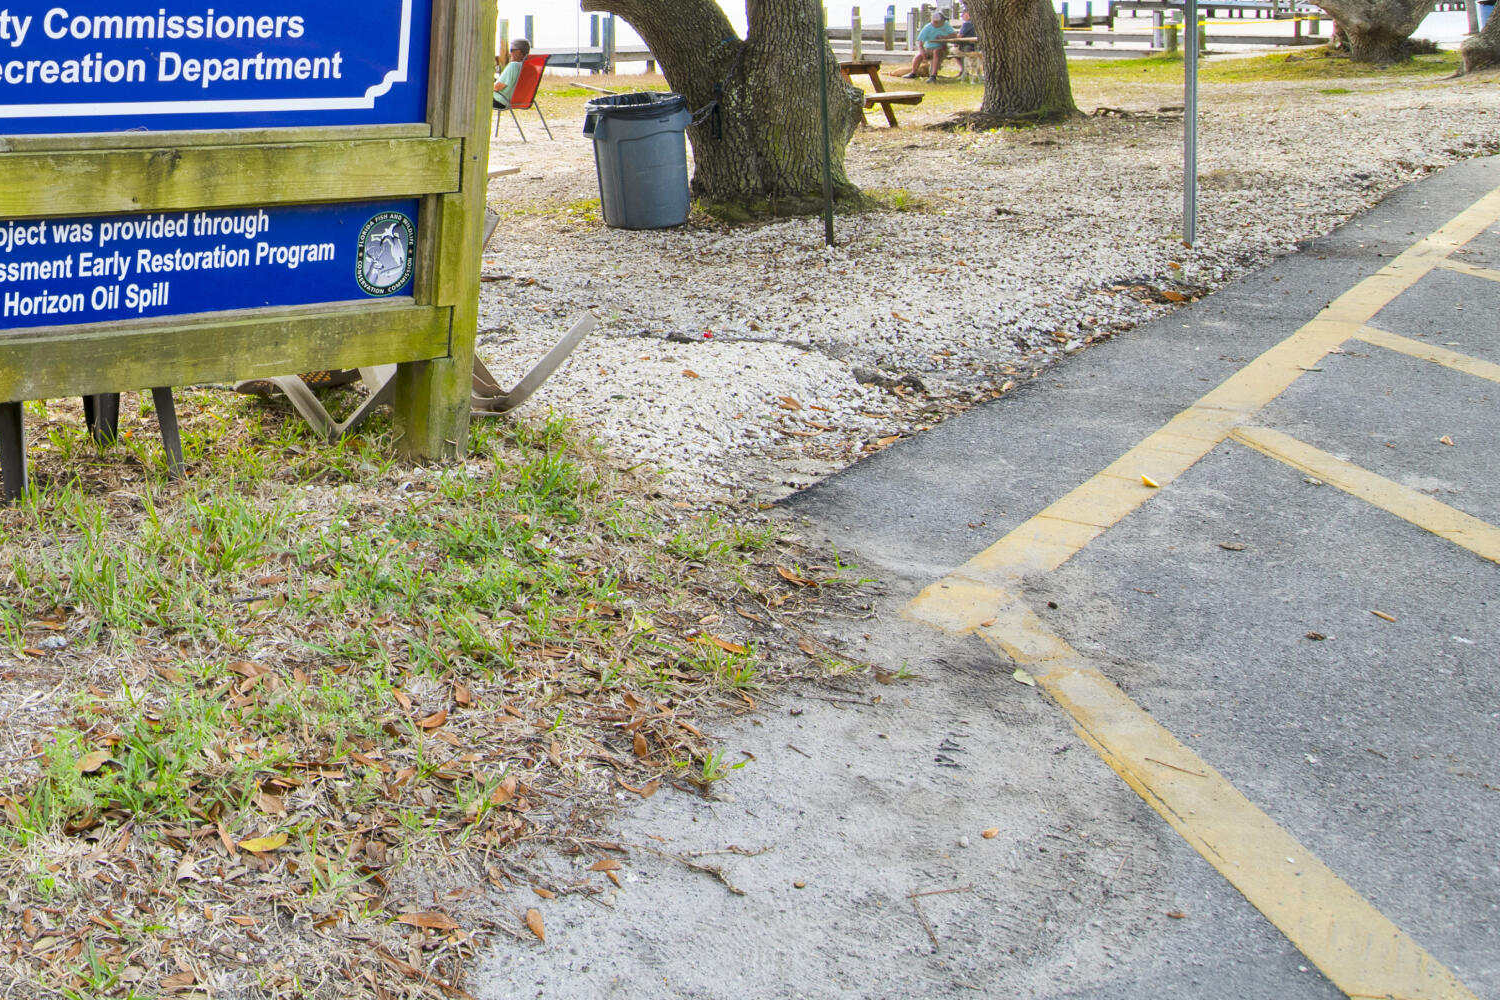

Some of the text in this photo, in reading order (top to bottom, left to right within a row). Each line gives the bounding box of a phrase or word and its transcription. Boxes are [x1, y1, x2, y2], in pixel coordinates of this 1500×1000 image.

[44, 8, 305, 39] Commissioners
[159, 51, 343, 89] Department
[53, 224, 93, 244] was
[100, 214, 189, 247] provided
[194, 210, 269, 239] through
[359, 213, 413, 247] FLORIDA FISH AND WILDLIFE
[79, 251, 132, 281] Early
[137, 244, 250, 274] Restoration
[256, 242, 335, 269] Program
[357, 258, 412, 294] CONSERVATION COMMISSION
[4, 289, 85, 317] Horizon
[92, 285, 120, 310] Oil
[125, 282, 170, 312] Spill
